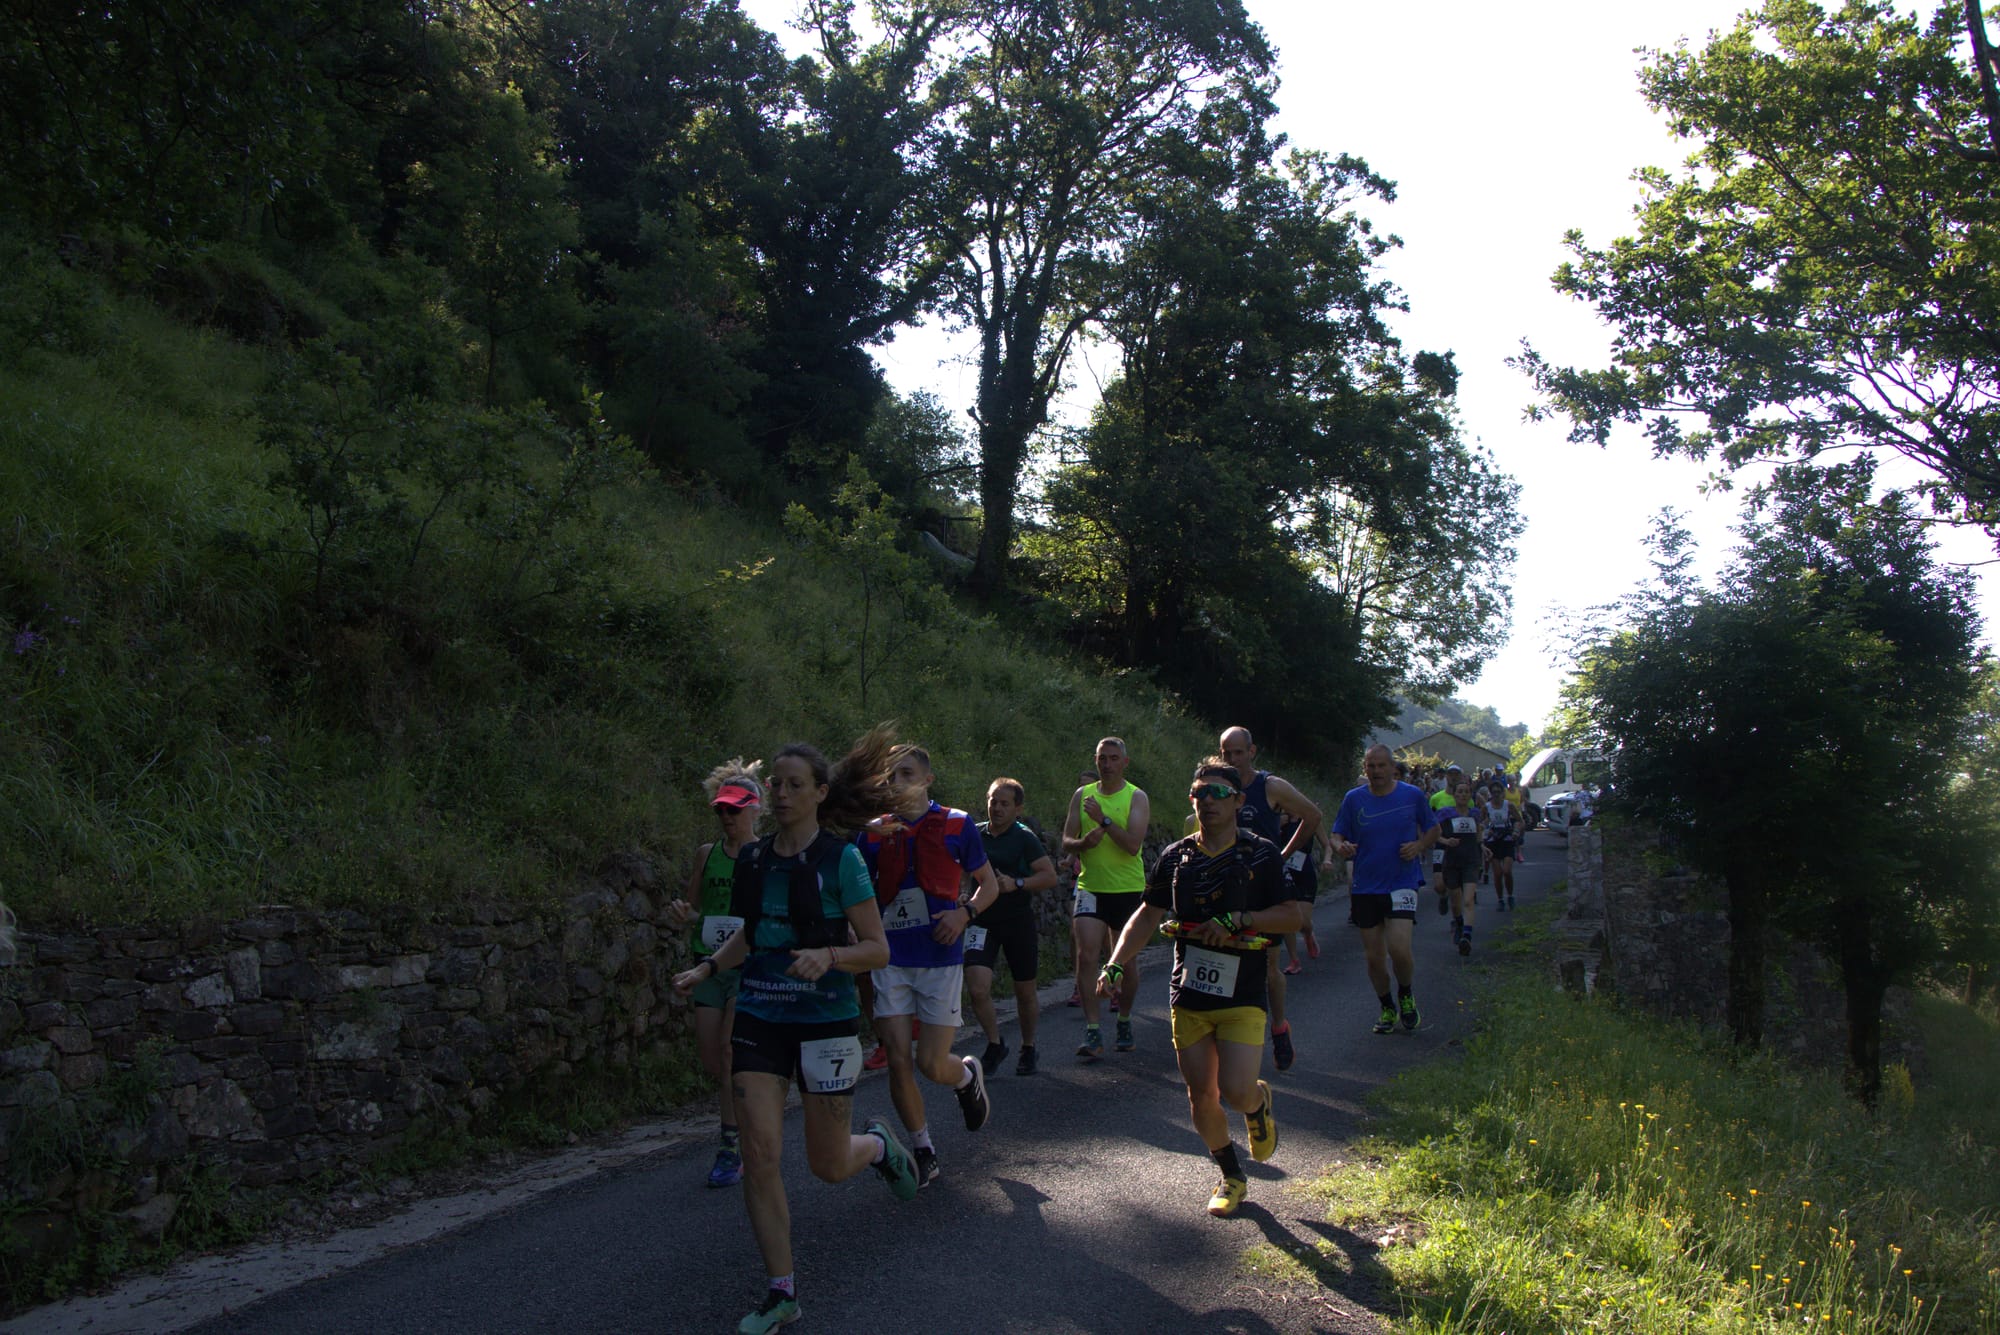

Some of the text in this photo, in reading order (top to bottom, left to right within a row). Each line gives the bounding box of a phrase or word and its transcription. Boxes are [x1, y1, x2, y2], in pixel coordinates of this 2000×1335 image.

[897, 905, 909, 919] 4
[890, 918, 921, 928] TUFF'S
[969, 934, 977, 943] 3
[1196, 966, 1220, 984] 60
[1190, 980, 1224, 994] TUFF'S
[753, 991, 798, 1003] RUNNING
[830, 1058, 845, 1078] 7
[817, 1077, 855, 1091] TUFF'S
